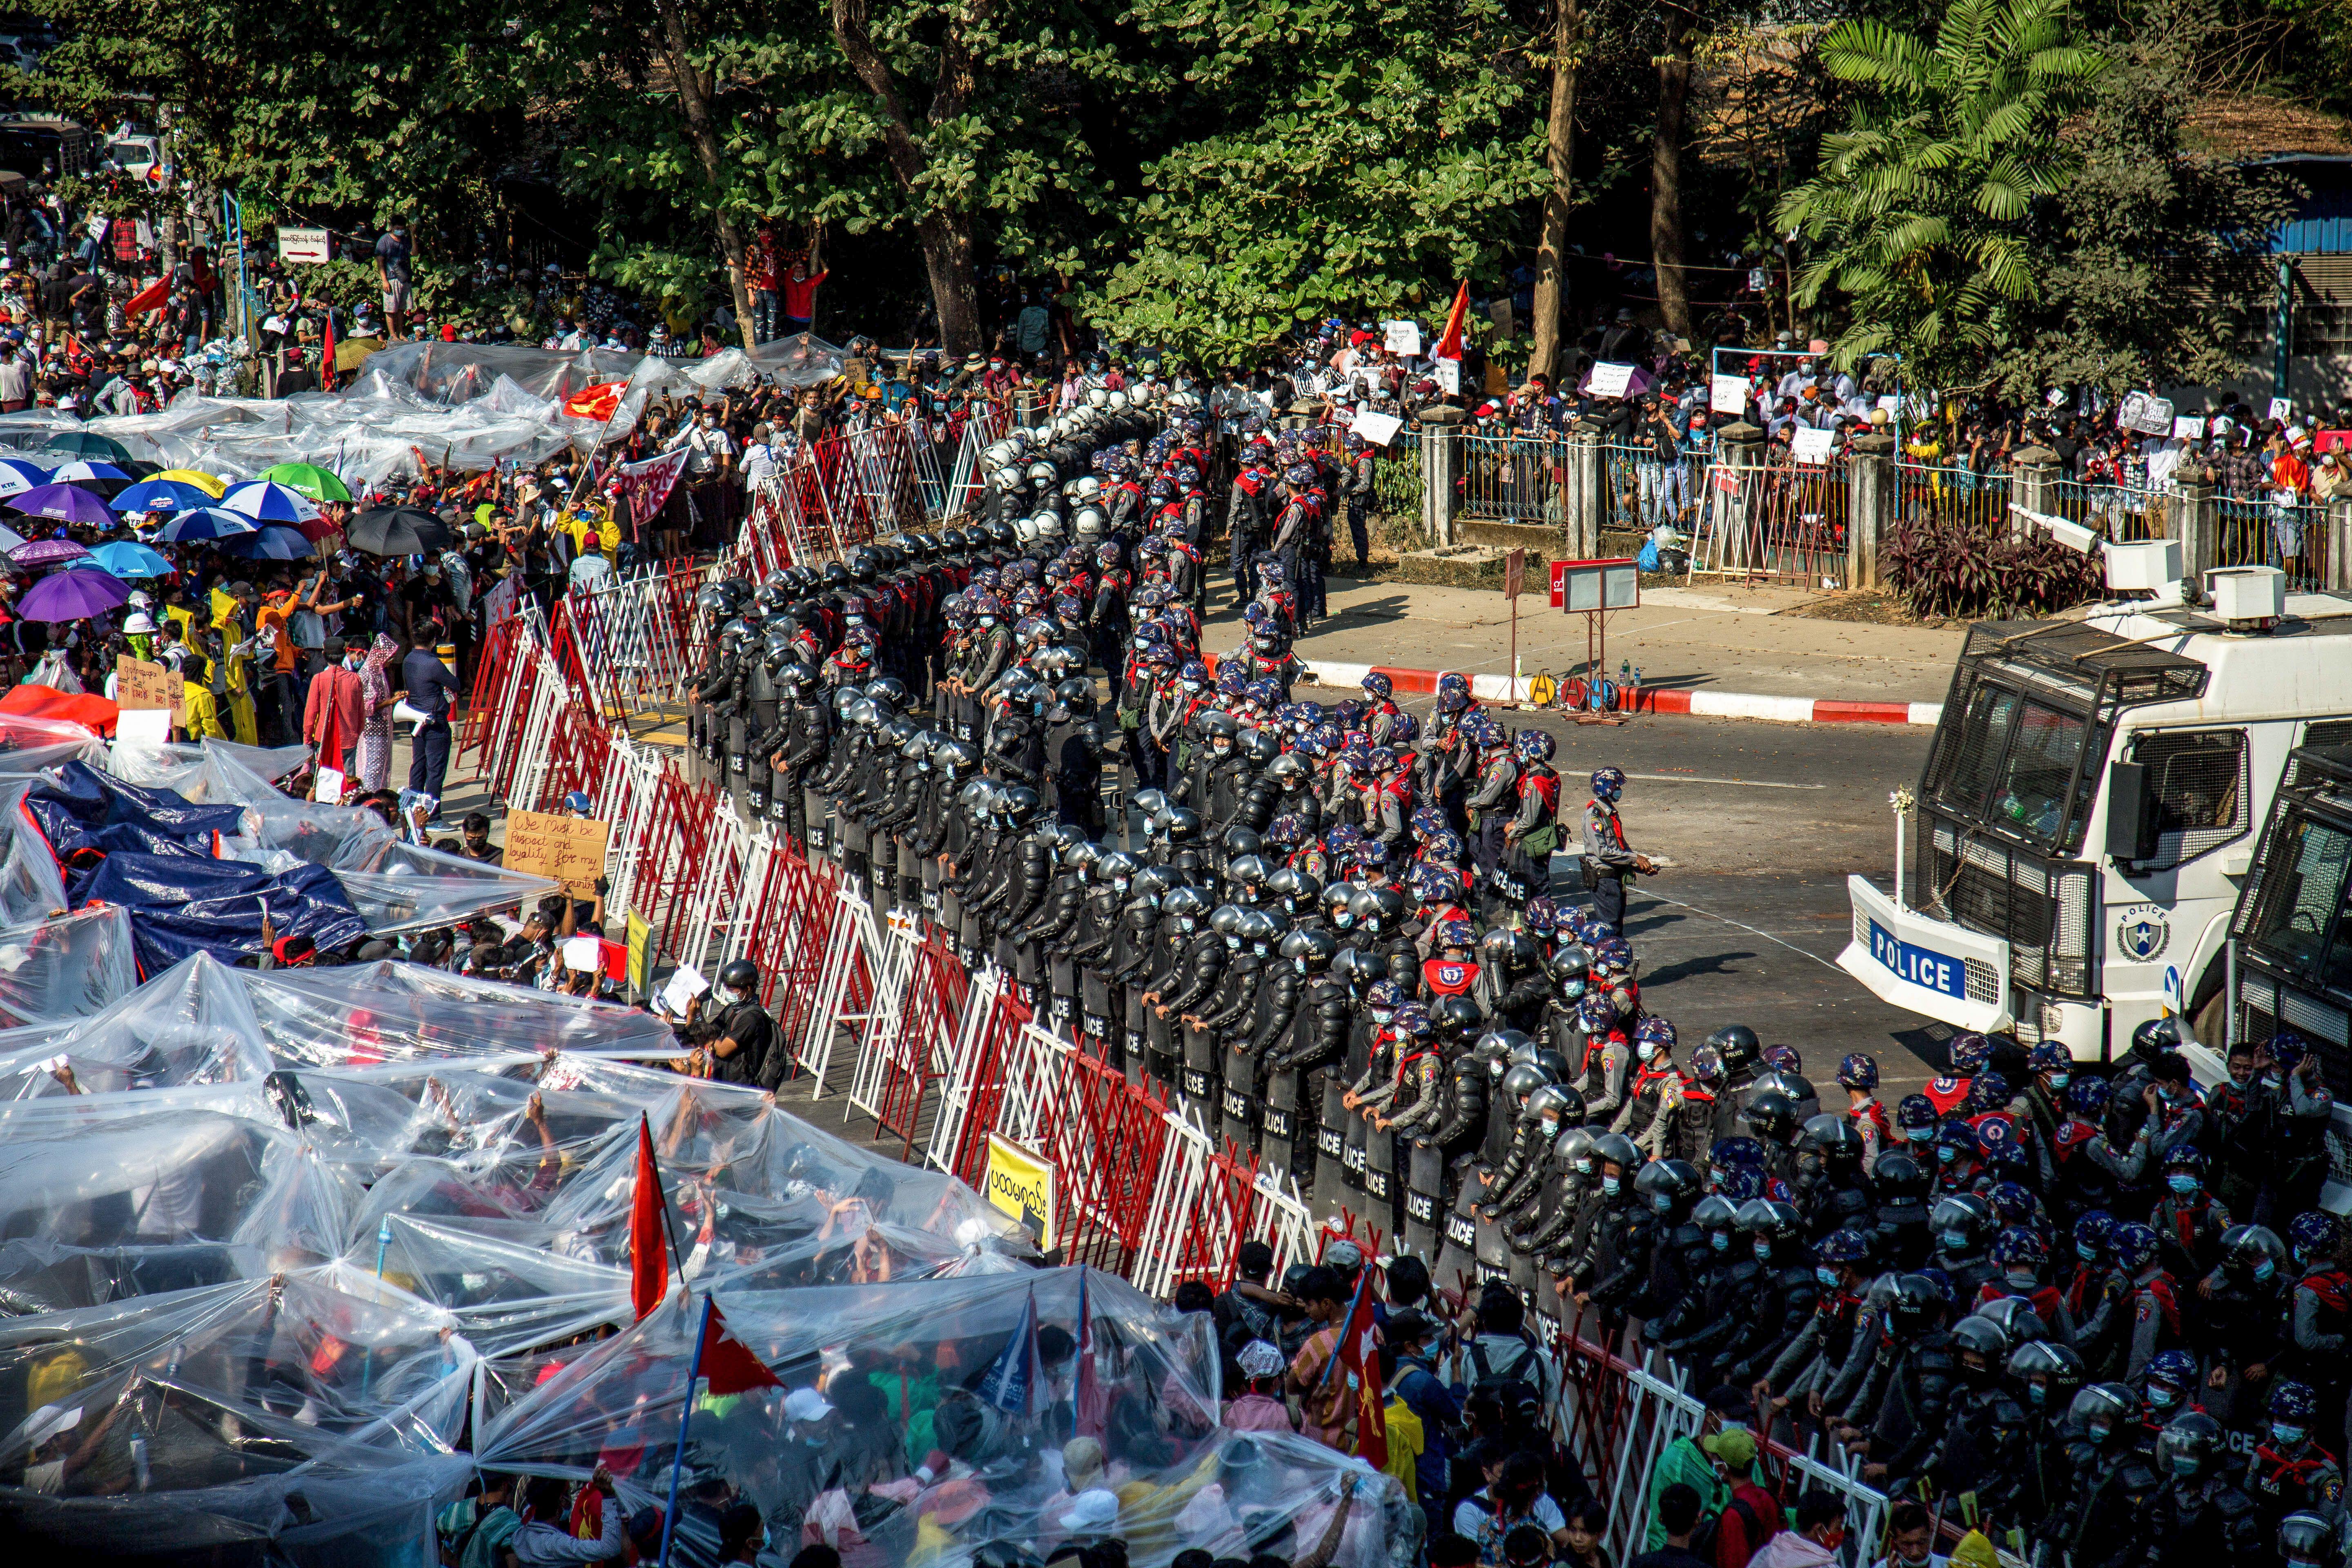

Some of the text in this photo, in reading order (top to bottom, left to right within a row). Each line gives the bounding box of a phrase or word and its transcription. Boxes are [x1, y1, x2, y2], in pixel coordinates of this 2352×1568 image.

[2149, 403, 2167, 412] FREE
[2142, 414, 2170, 424] LEADER
[290, 483, 317, 493] acer
[892, 692, 903, 702] POLICE
[1011, 804, 1025, 813] POLICE
[514, 816, 597, 836] We Must be
[581, 857, 598, 871] my
[1296, 892, 1312, 902] POLICE
[2121, 905, 2166, 922] POLICE
[1272, 932, 1288, 942] POLICE
[1876, 932, 1951, 993] POLICE
[1442, 1018, 1455, 1027] POLICE
[2139, 1036, 2155, 1046] POLICE
[1725, 1050, 1744, 1058] POLICE
[1223, 1091, 1245, 1118] OLICE
[1679, 1186, 1697, 1198] POLICE
[1448, 1217, 1474, 1246] OLICE
[1777, 1229, 1797, 1241] POLICE
[2125, 1415, 2143, 1424] POLICE
